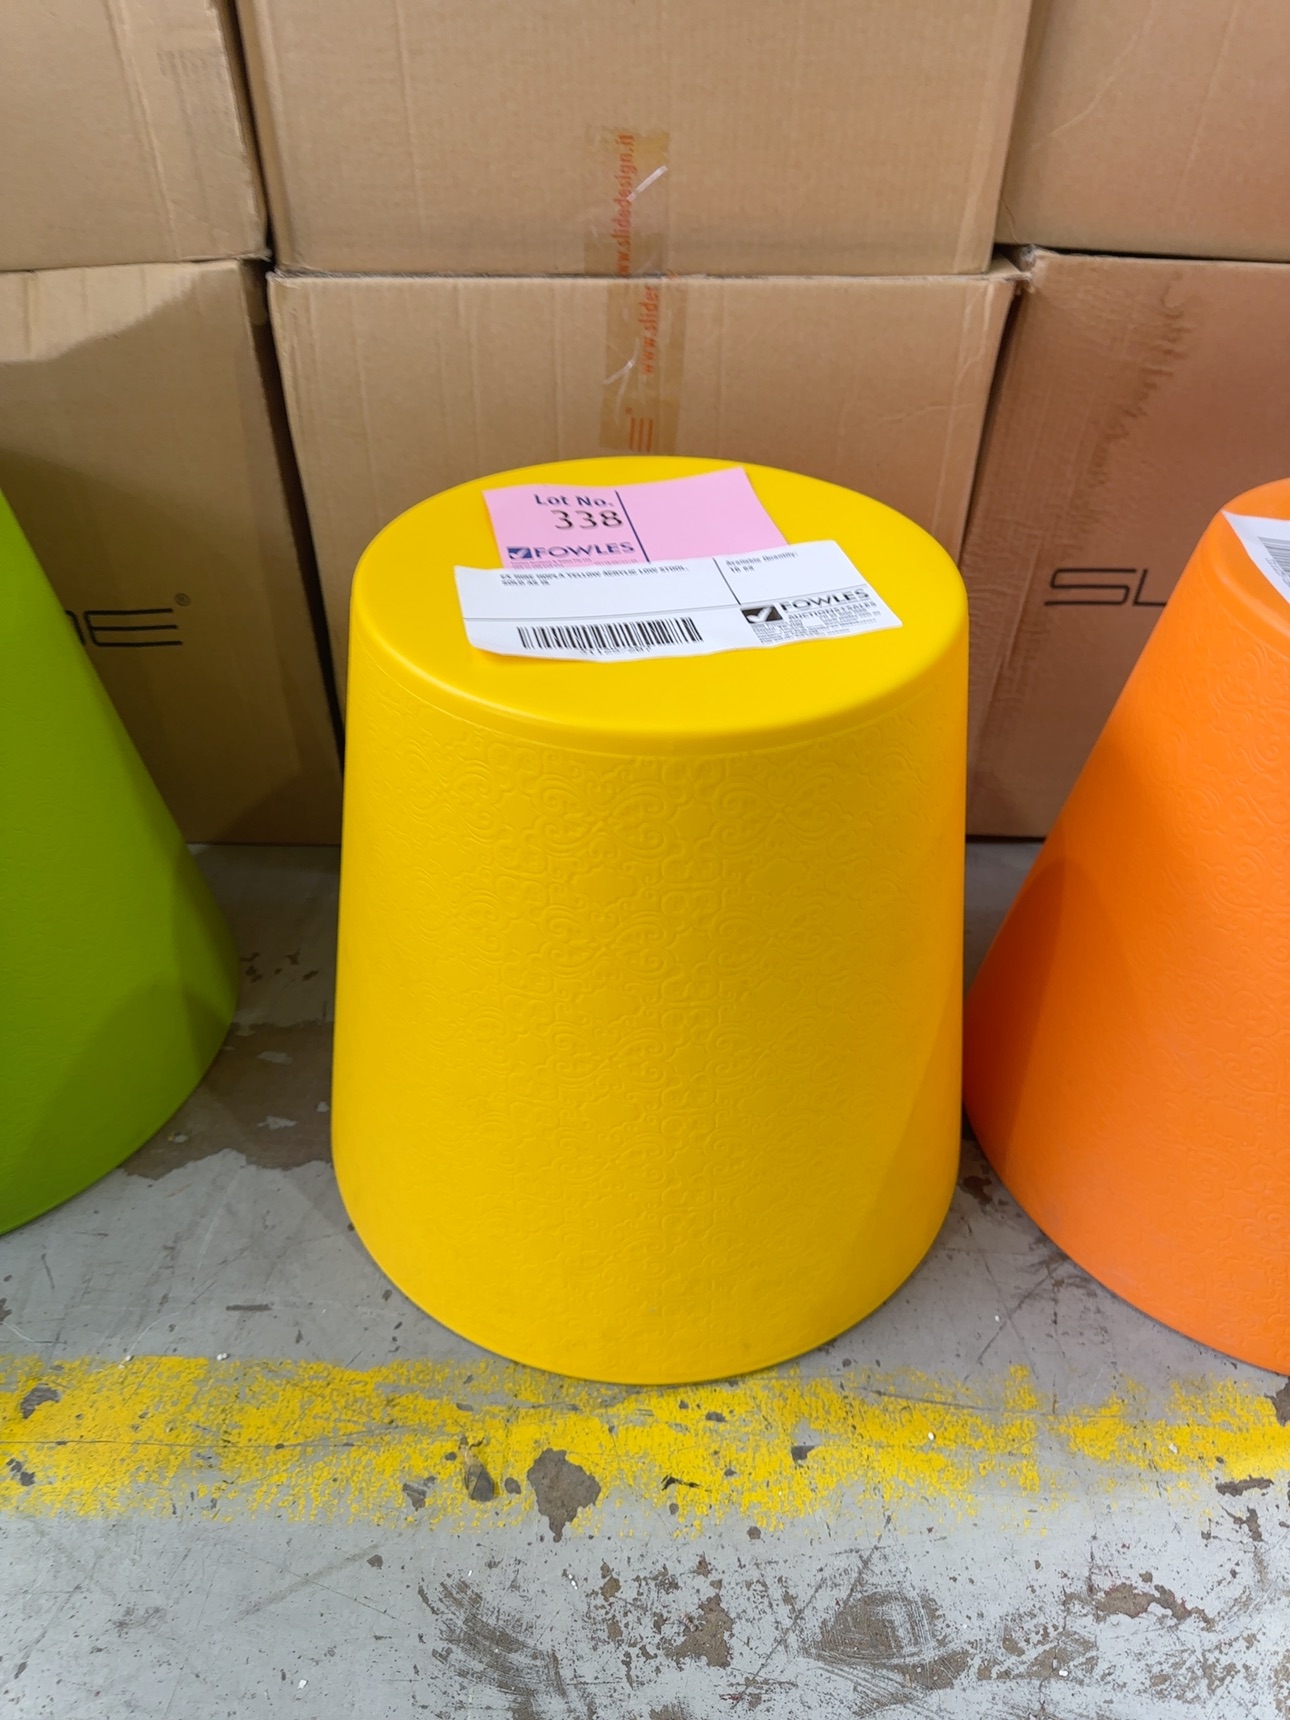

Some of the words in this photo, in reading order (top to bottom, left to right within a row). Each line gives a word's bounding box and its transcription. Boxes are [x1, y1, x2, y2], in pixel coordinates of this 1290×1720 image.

[533, 493, 570, 506] Lot
[575, 494, 615, 507] No.
[550, 509, 623, 530] 338
[533, 541, 636, 559] FOWLES
[780, 588, 869, 611] FOWLES
